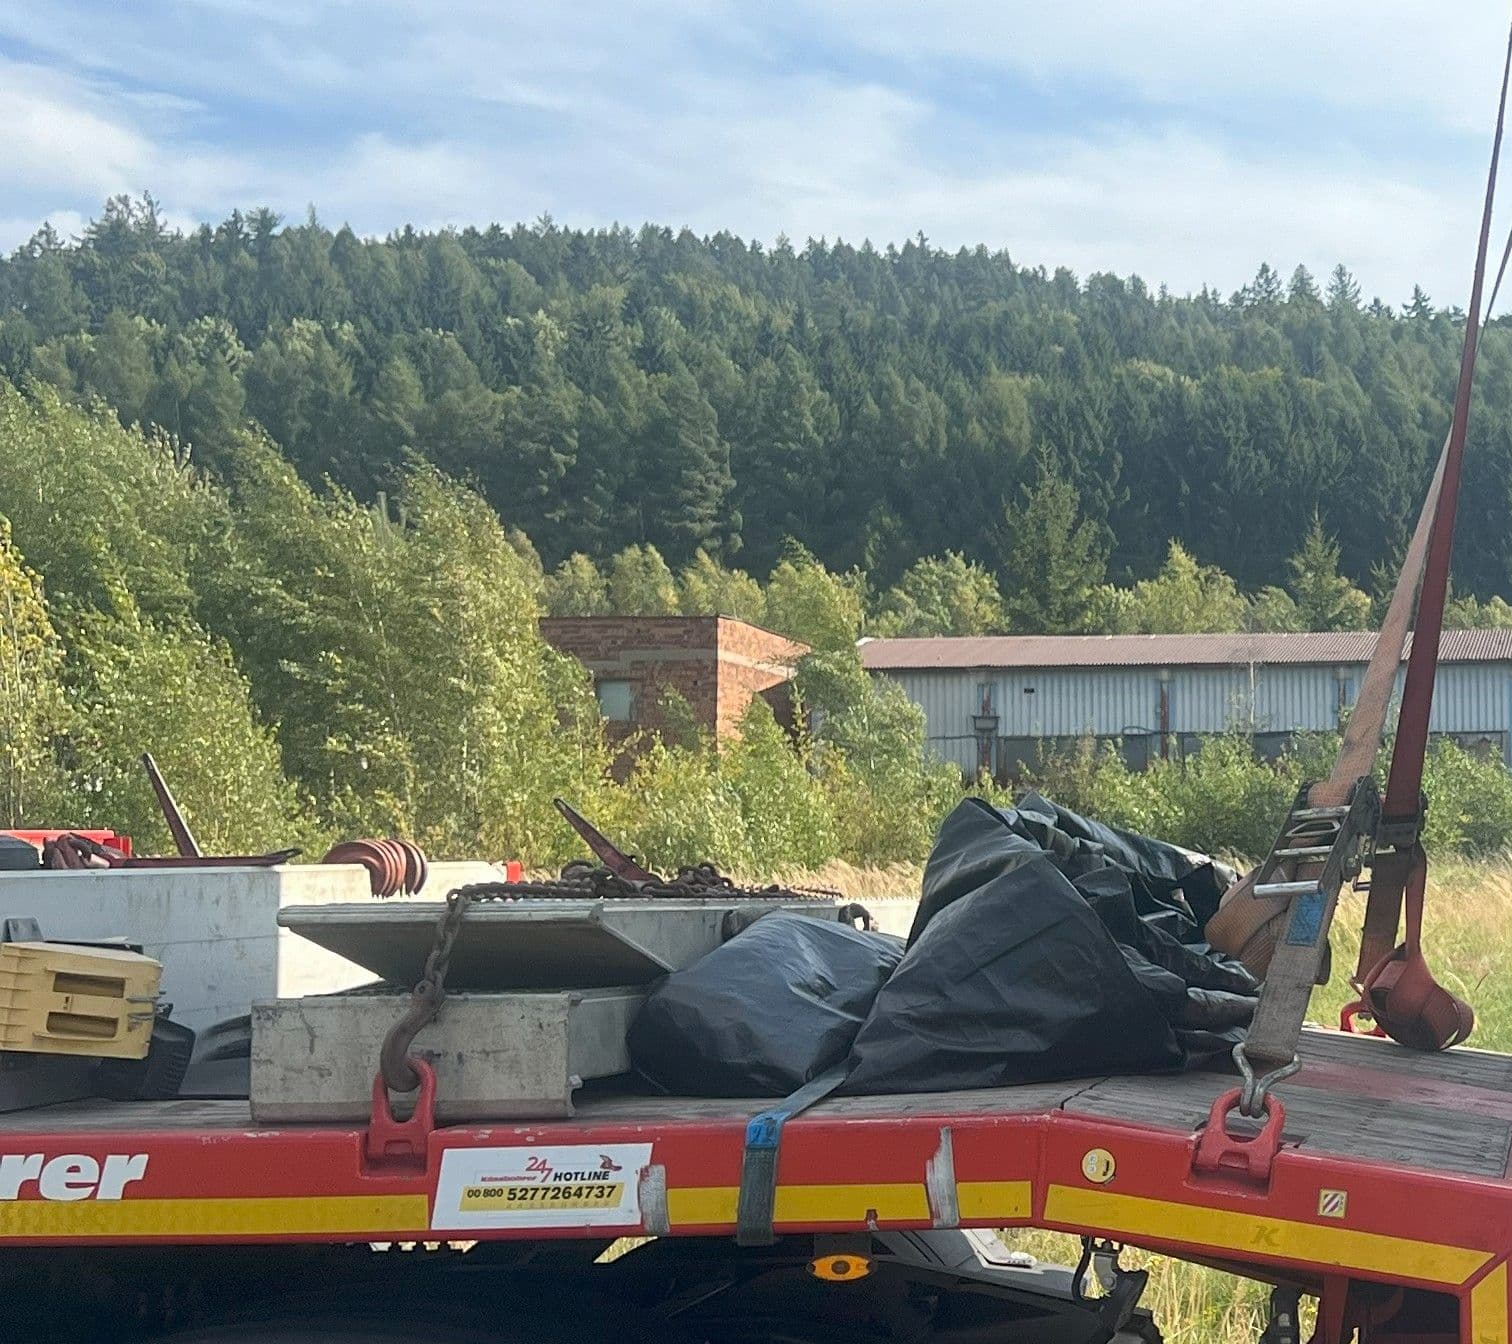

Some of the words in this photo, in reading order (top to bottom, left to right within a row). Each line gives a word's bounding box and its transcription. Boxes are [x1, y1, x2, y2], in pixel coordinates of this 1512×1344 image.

[553, 1171, 610, 1182] HOTLINE
[467, 1190, 481, 1198] 00
[483, 1188, 503, 1197] 800
[507, 1185, 616, 1201] 5277264737
